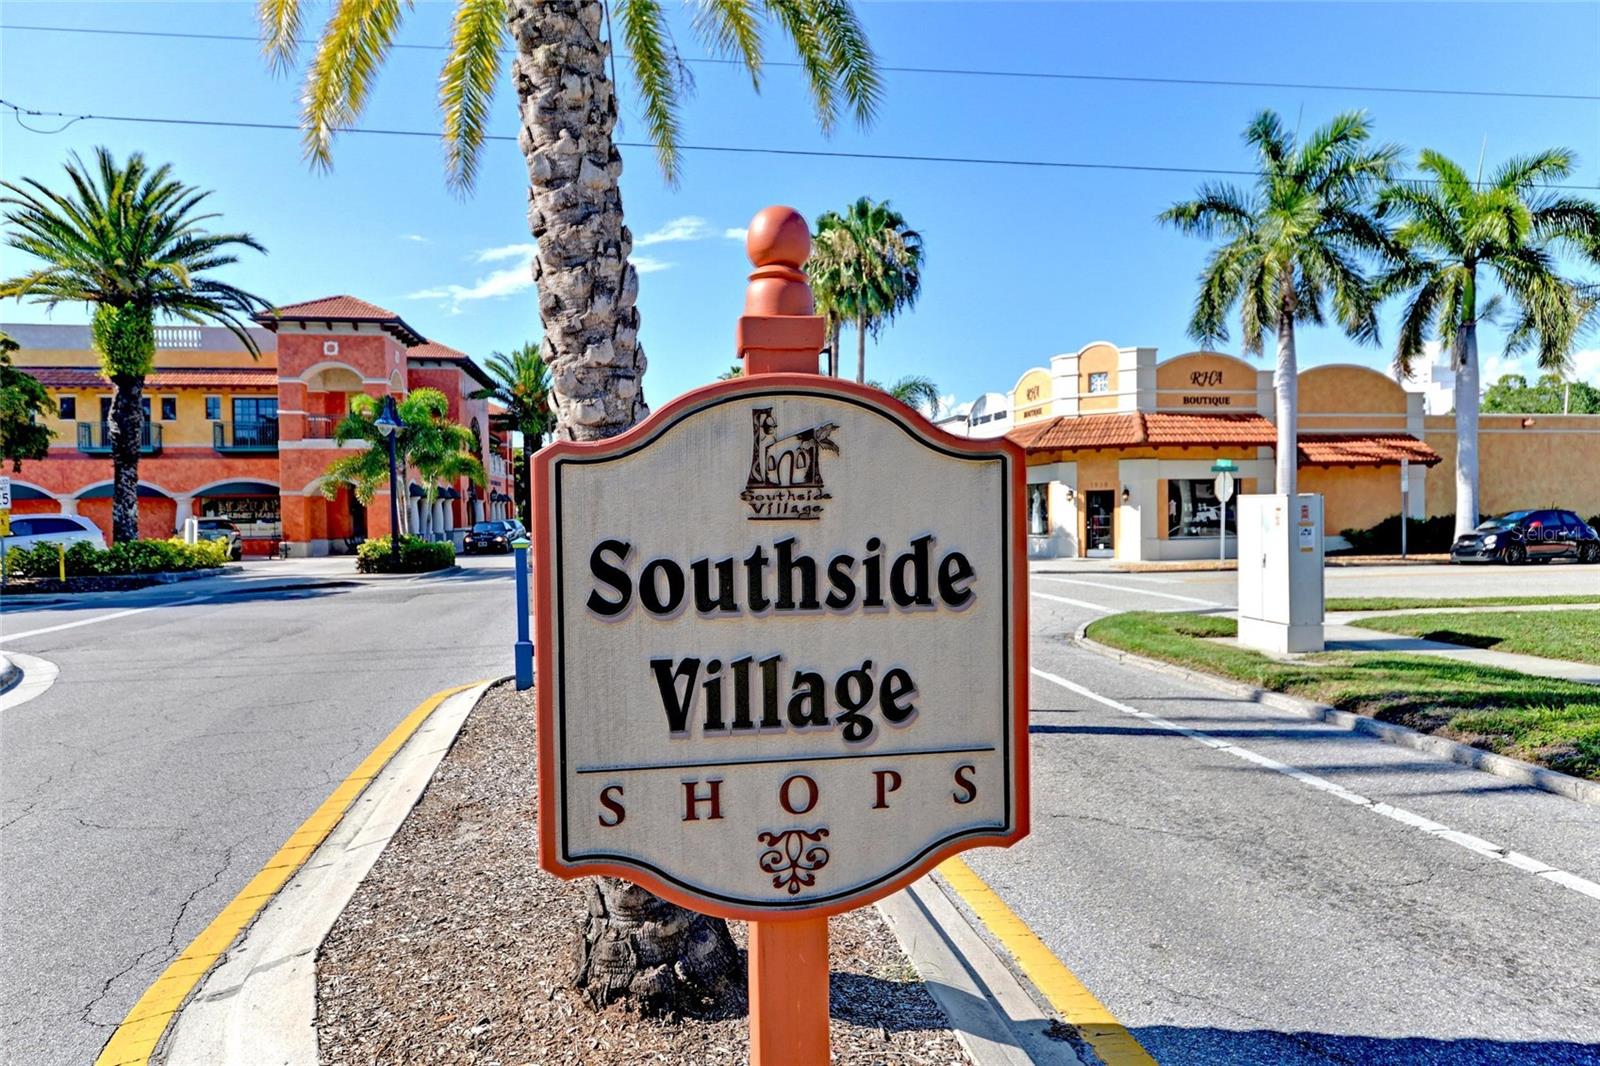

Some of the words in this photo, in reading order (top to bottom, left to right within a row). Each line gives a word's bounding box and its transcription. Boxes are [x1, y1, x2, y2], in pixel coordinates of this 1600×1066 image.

[1183, 396, 1231, 406] BOUTIQUE
[0, 492, 9, 506] 5
[740, 488, 833, 502] Southside
[748, 502, 825, 518] Village
[586, 534, 974, 617] Southside
[649, 654, 916, 743] Village
[598, 764, 978, 828] SHOPS
